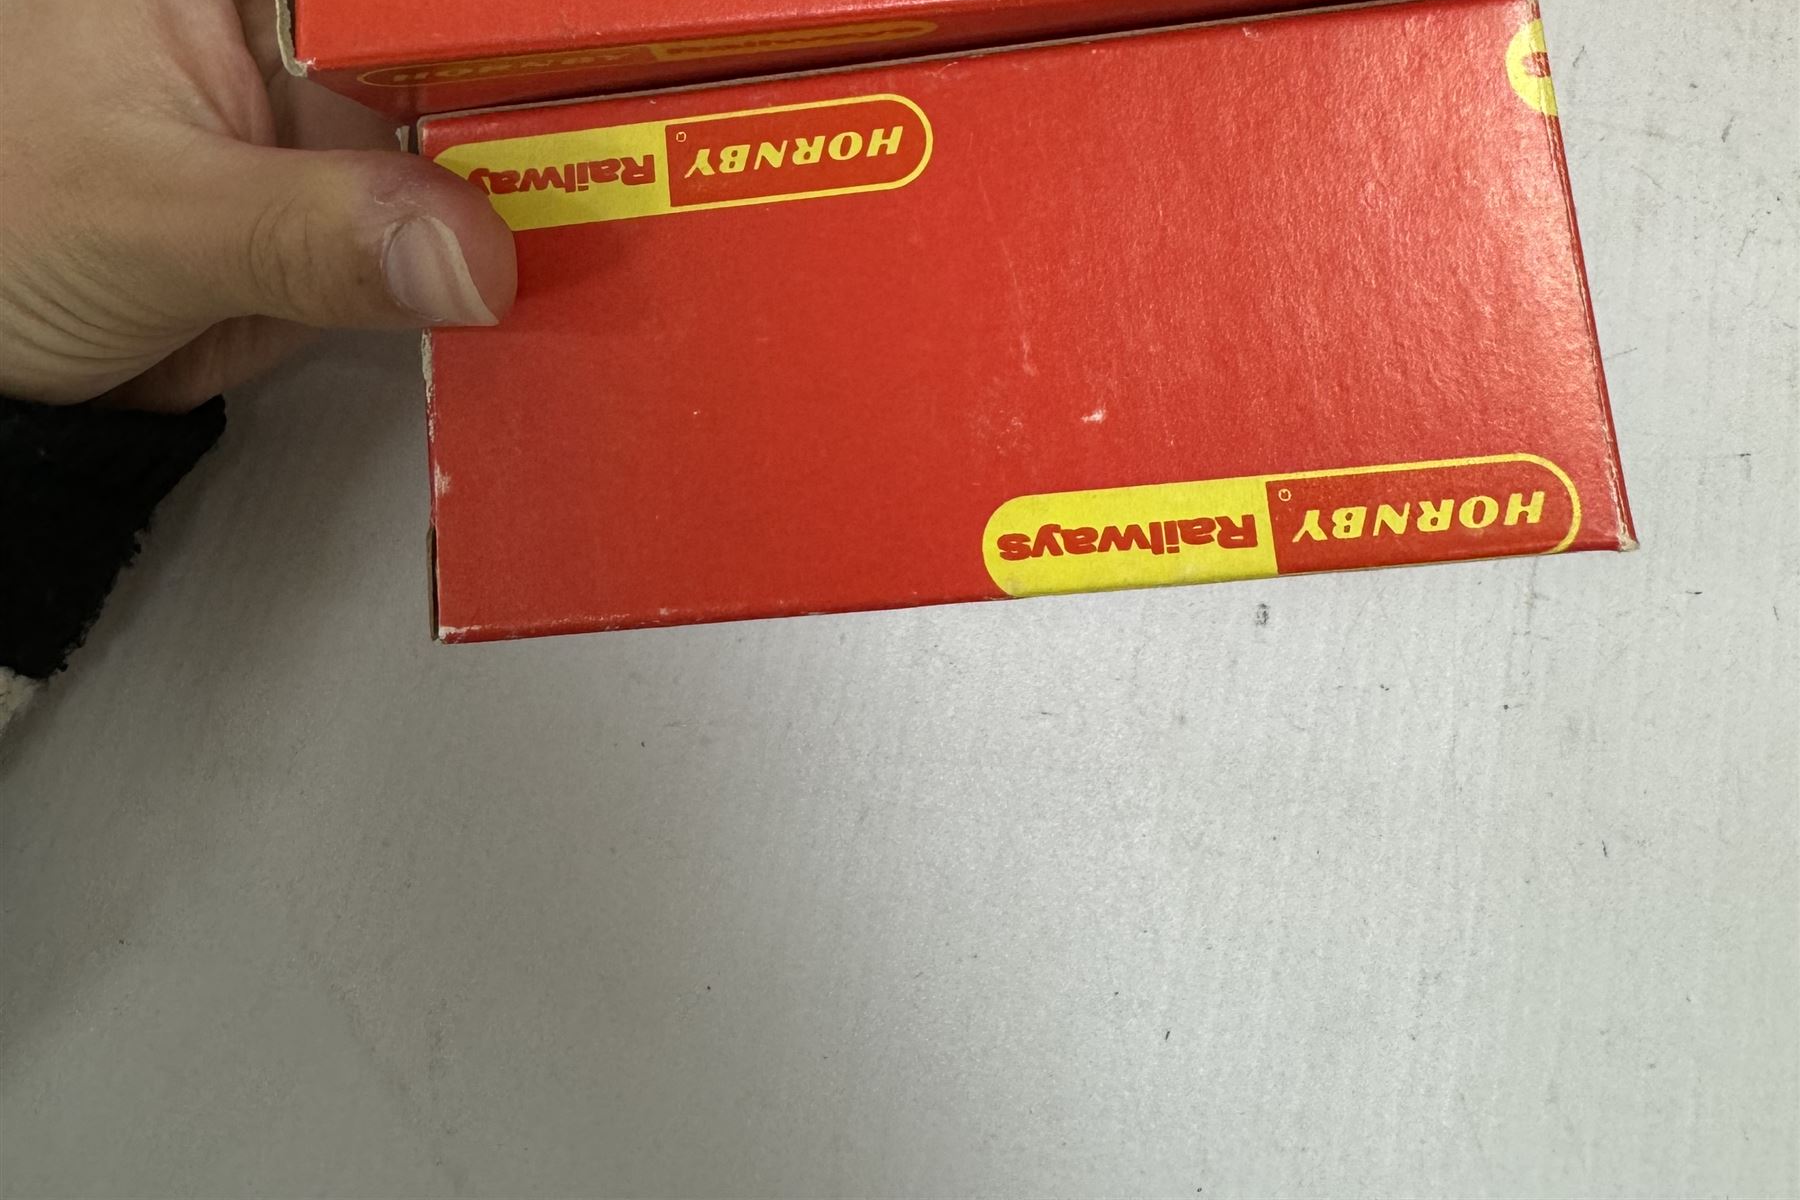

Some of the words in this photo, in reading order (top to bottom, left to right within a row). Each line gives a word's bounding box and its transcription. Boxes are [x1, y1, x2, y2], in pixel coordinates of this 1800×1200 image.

[467, 154, 656, 196] Railway
[684, 125, 904, 179] HORNBY
[997, 513, 1259, 561] Railways
[1292, 490, 1546, 543] HORNBY
